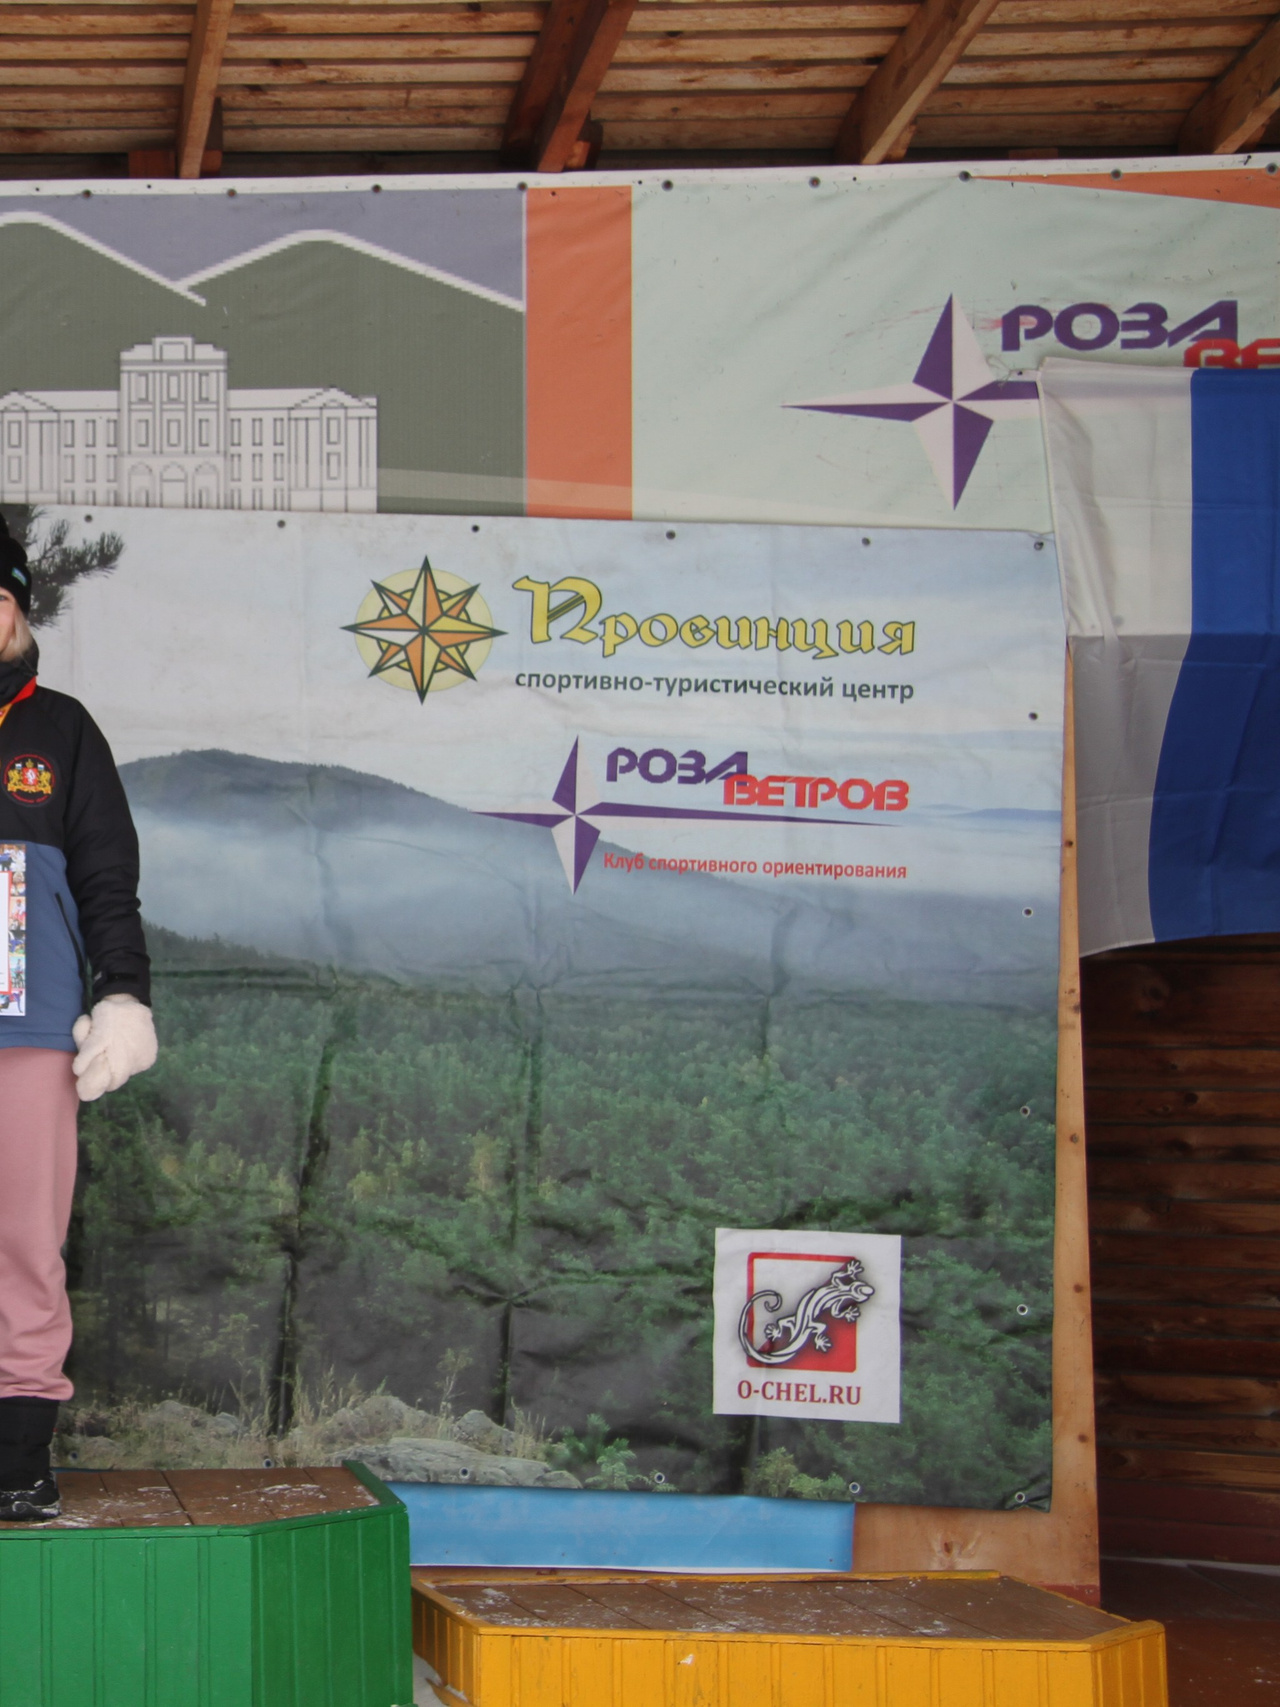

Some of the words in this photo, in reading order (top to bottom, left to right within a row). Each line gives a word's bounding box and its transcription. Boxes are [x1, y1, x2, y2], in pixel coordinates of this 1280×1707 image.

[1001, 301, 1238, 352] РОЗА
[512, 575, 916, 659] Провинция
[514, 671, 835, 698] спортивно-туристический
[841, 680, 915, 704] центр
[605, 747, 749, 786] РОЗА
[723, 774, 909, 811] ВЕТРОВ
[603, 853, 644, 873] Клуб
[648, 855, 758, 876] спортивного
[762, 861, 907, 880] ориентирования
[737, 1379, 862, 1405] O-CHEL.RU
